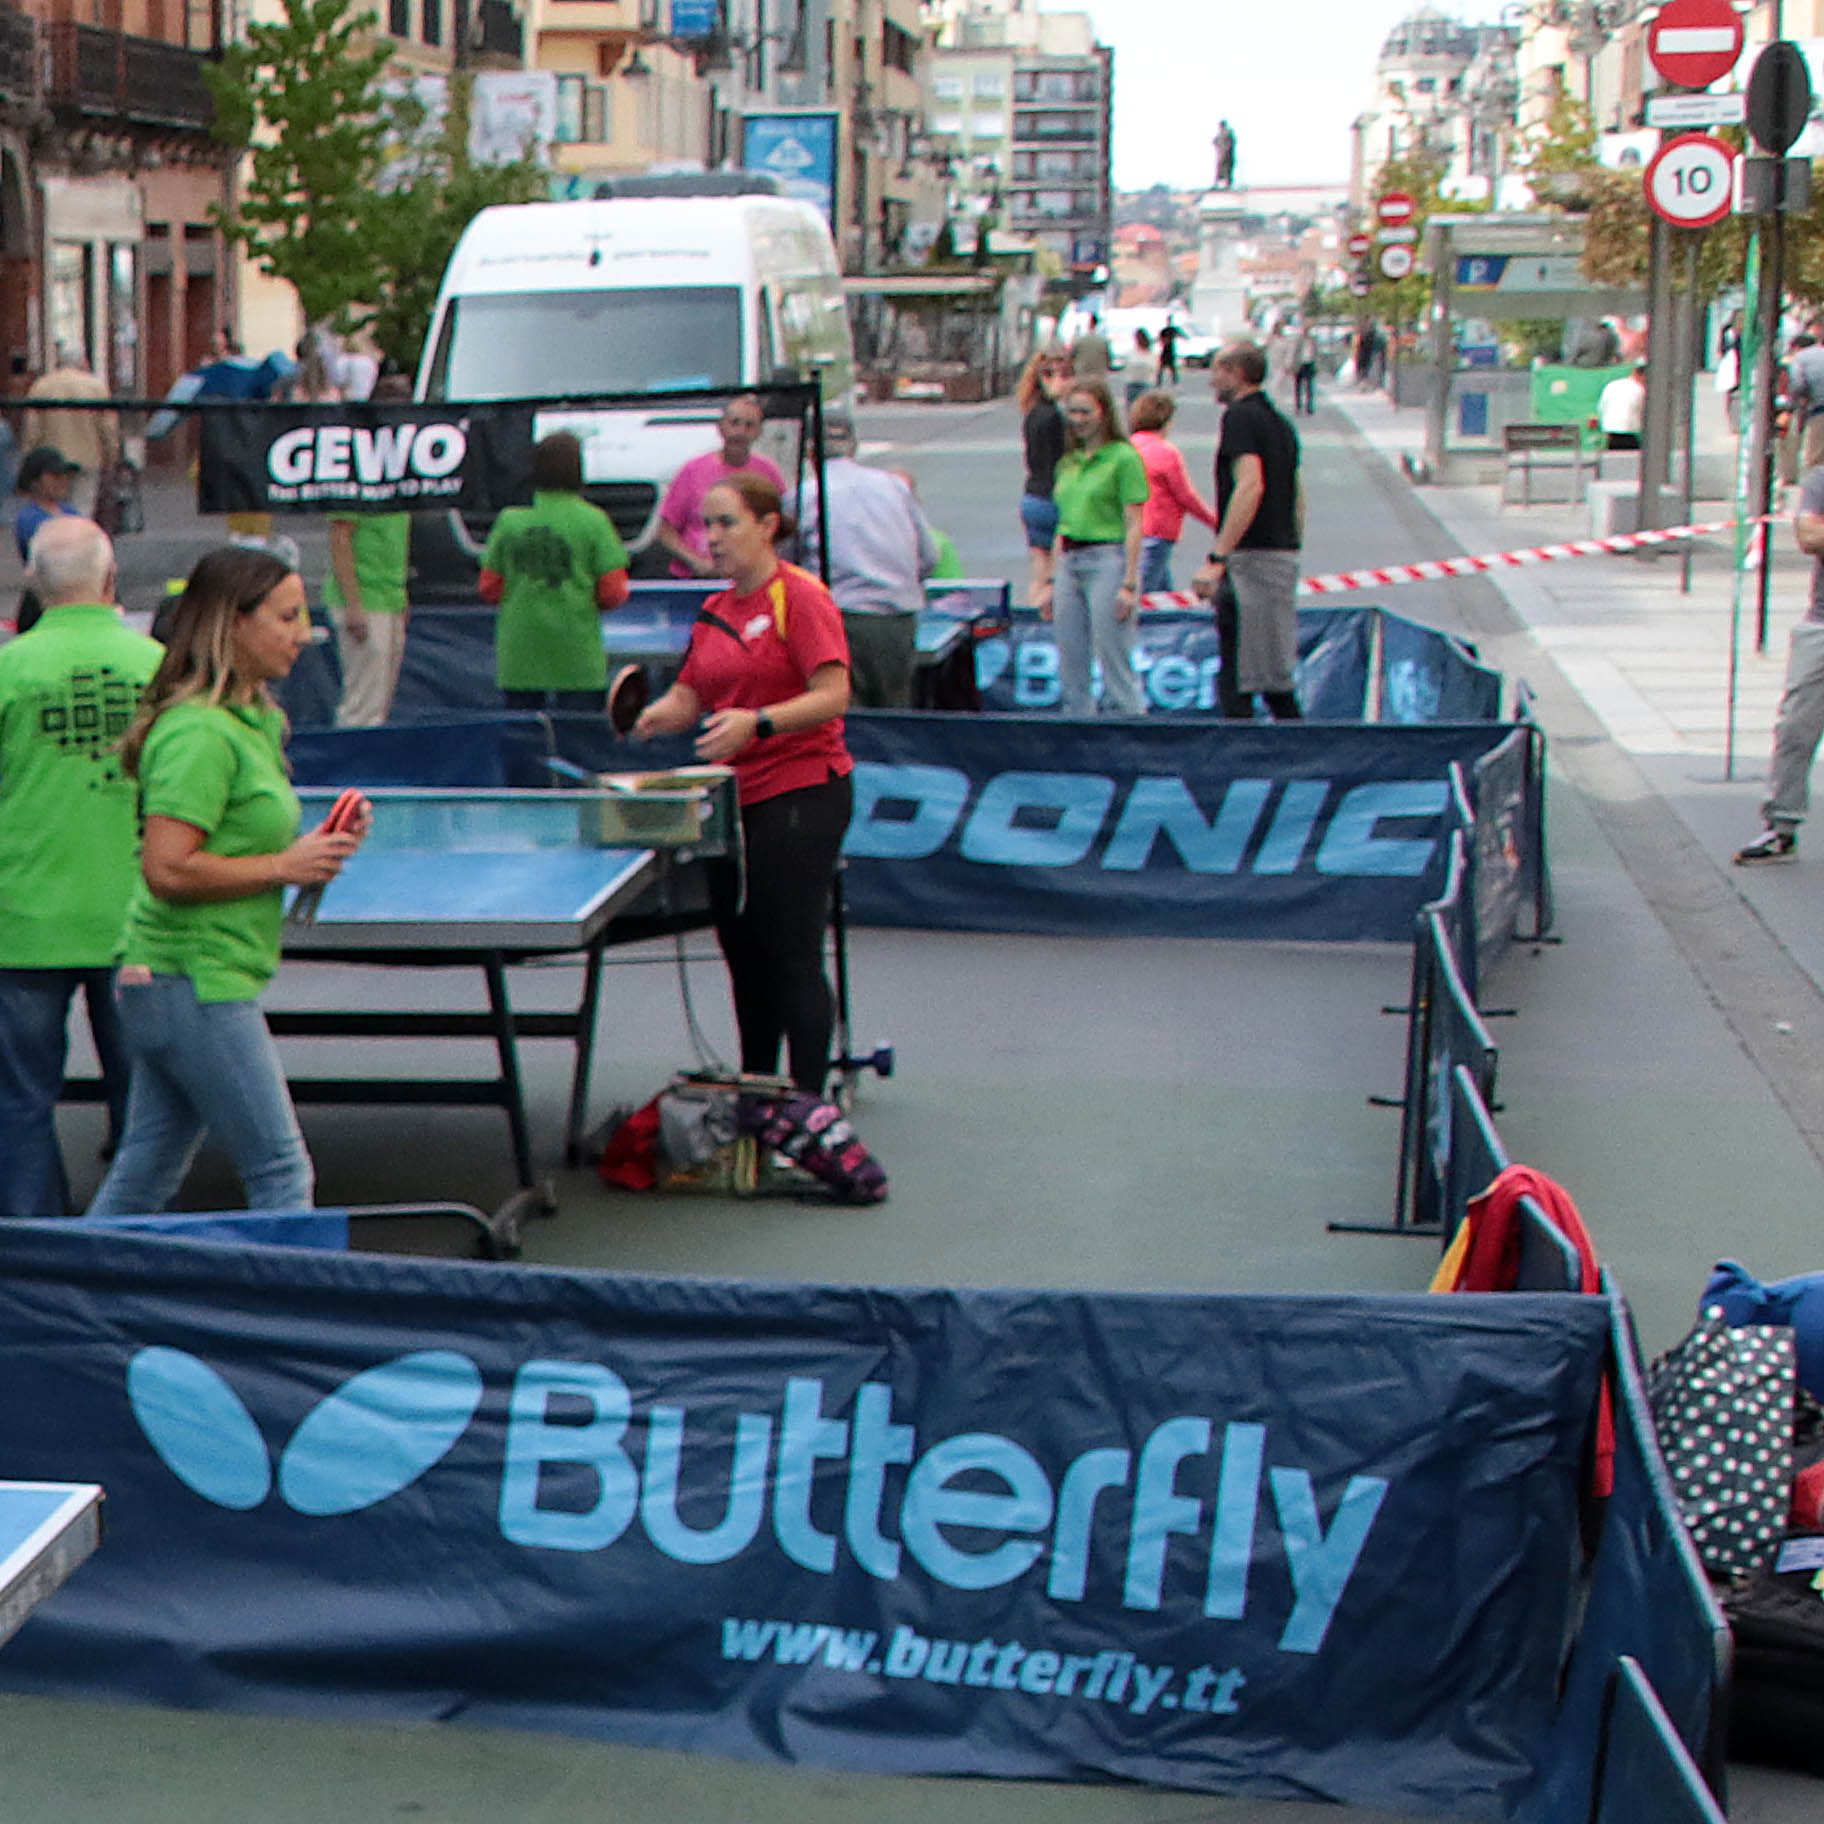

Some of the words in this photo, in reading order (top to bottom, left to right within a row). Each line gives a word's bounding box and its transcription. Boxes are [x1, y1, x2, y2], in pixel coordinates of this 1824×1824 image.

[1673, 167, 1712, 197] 10
[267, 423, 467, 486] GEWO
[840, 759, 1451, 877] DONIC
[499, 1358, 1389, 1655] Butterfly
[720, 1616, 1247, 1714] www.butterfly.tt
